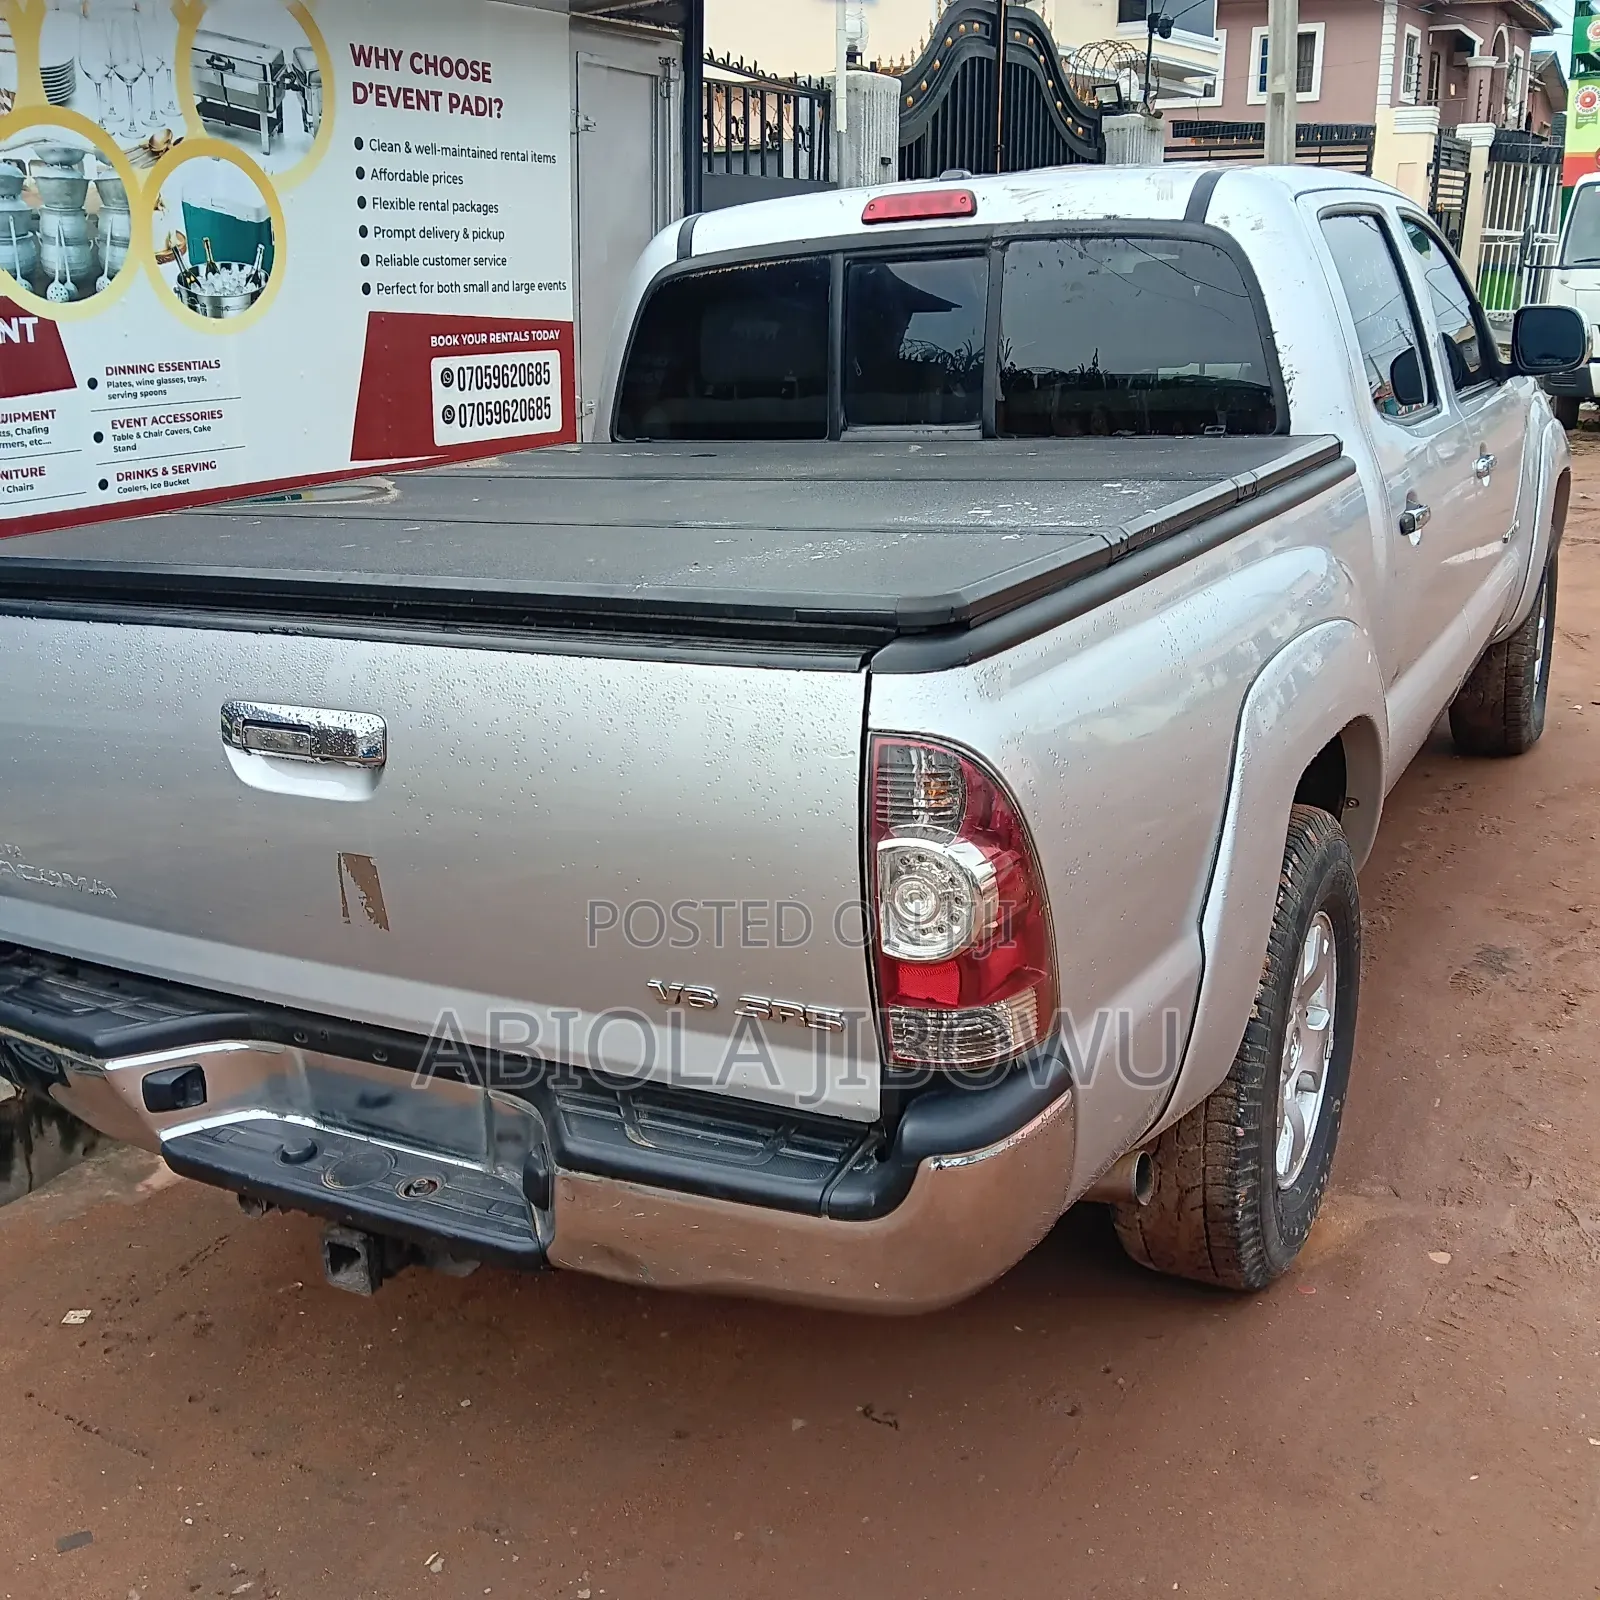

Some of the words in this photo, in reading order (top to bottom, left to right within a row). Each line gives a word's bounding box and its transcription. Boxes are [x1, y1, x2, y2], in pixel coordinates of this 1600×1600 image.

[349, 43, 403, 72] WHY
[409, 52, 492, 83] CHOOSE
[352, 81, 443, 112] D'EVENT
[448, 92, 504, 119] PADI?
[369, 138, 401, 153] Clean
[404, 141, 412, 153] &
[415, 142, 498, 160] well-maintained
[500, 149, 529, 162] rental
[531, 151, 557, 164] items
[370, 168, 429, 183] Affordable
[432, 171, 464, 186] prices
[372, 196, 416, 211] Flexible
[418, 199, 449, 212] rental
[452, 200, 499, 216] packages
[373, 226, 416, 241] Prompt
[418, 226, 460, 242] delivery
[462, 228, 470, 239] &
[472, 227, 505, 242] pickup
[375, 254, 420, 267] Reliable
[422, 255, 471, 267] customer
[473, 254, 507, 267] service
[376, 282, 417, 295] Perfect
[419, 281, 434, 294] for
[436, 281, 461, 294] both
[463, 281, 490, 293] small
[491, 281, 510, 293] and
[512, 281, 536, 295] large
[537, 280, 567, 292] events
[430, 335, 460, 347] BOOK
[461, 333, 488, 345] YOUR
[489, 331, 529, 343] RENTALS
[531, 329, 560, 341] TODAY
[105, 363, 155, 376] DINNING
[158, 359, 221, 373] ESSENTIALS
[457, 361, 551, 392] 07059620685
[106, 378, 134, 389] Plates,
[135, 377, 155, 386] wine
[156, 376, 186, 387] glasses,
[187, 374, 207, 384] trays,
[107, 389, 138, 400] serving
[139, 388, 167, 398] spoons
[111, 416, 148, 430] EVENT
[150, 409, 223, 425] ACCESSORIES
[458, 396, 551, 429] 07059620685
[15, 425, 49, 436] Chafing
[112, 432, 134, 442] Table
[135, 432, 141, 440] &
[142, 429, 163, 439] Chair
[164, 427, 192, 437] Covers,
[193, 424, 212, 434] Cake
[113, 443, 137, 454] Stand
[116, 467, 158, 482] DRINKS
[161, 466, 169, 477] &
[171, 460, 217, 476] SERVING
[6, 482, 35, 494] Chairs
[117, 484, 149, 495] Coolers,
[150, 482, 162, 490] Ice
[163, 478, 190, 488] Bucket
